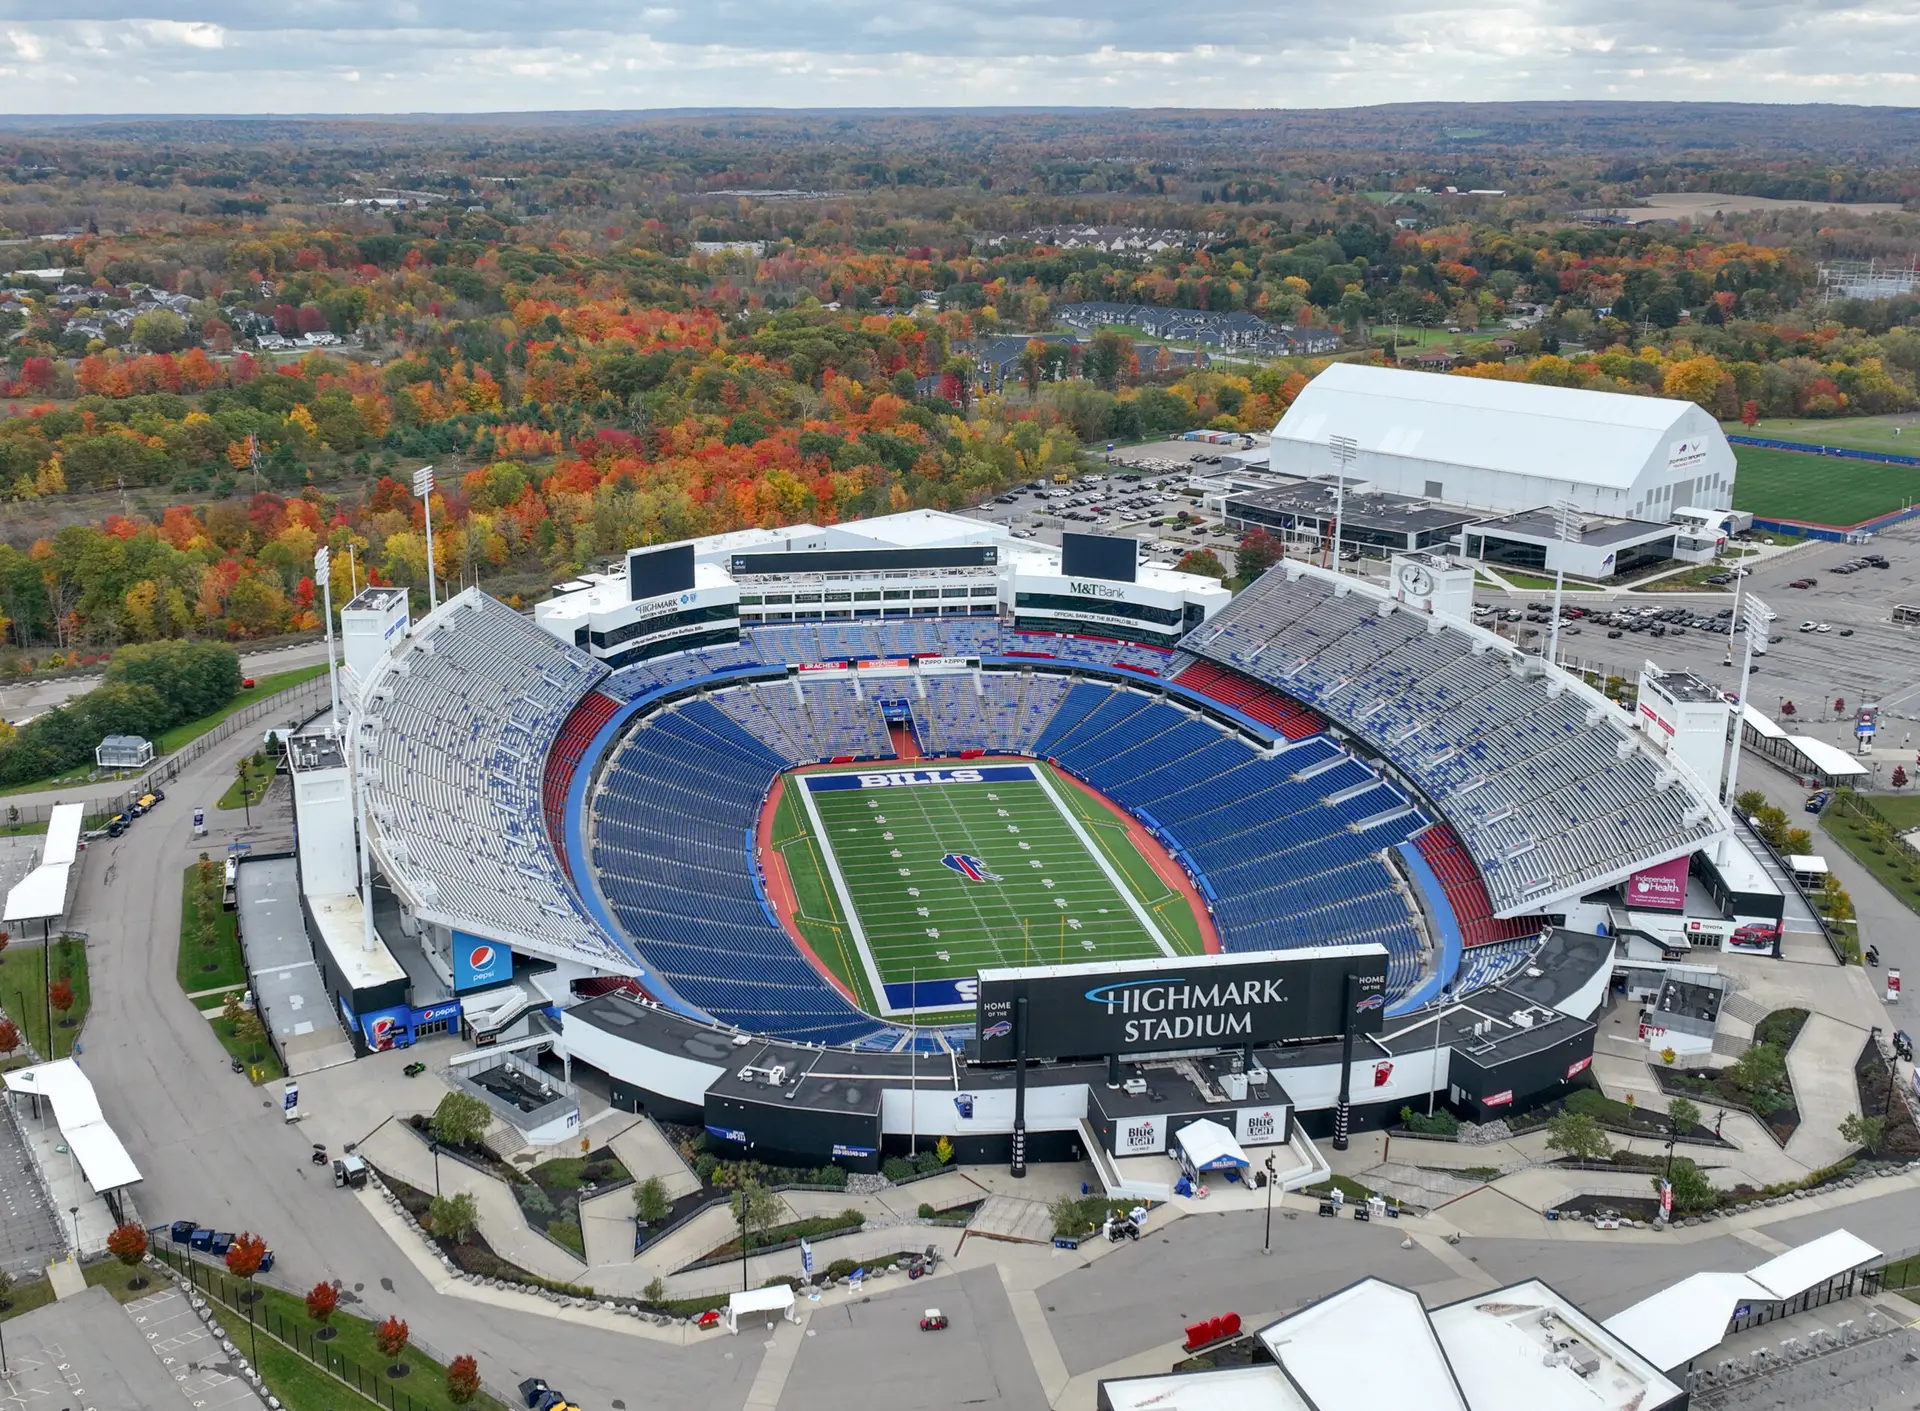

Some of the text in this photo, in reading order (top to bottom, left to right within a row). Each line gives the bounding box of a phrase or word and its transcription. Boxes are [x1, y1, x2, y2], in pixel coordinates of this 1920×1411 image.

[1070, 582, 1124, 599] M&T Bank
[639, 599, 678, 614] HIGHMARK
[641, 611, 657, 619] WESTERN
[645, 635, 657, 643] Health
[679, 627, 694, 635] Buffalo
[857, 770, 984, 788] BILLS
[1635, 875, 1675, 885] Independent
[1650, 883, 1679, 893] Health
[473, 971, 495, 981] pepsi
[1359, 976, 1385, 984] HOME
[1107, 979, 1284, 1015] HIGHMARK
[435, 1006, 457, 1018] pepsi
[984, 1002, 1011, 1011] HOME
[1124, 1012, 1252, 1043] STADIUM
[1248, 1117, 1274, 1127] Blue
[1128, 1127, 1154, 1138] Blue
[1247, 1126, 1274, 1137] LIGHT
[1127, 1137, 1155, 1147] LIGHT
